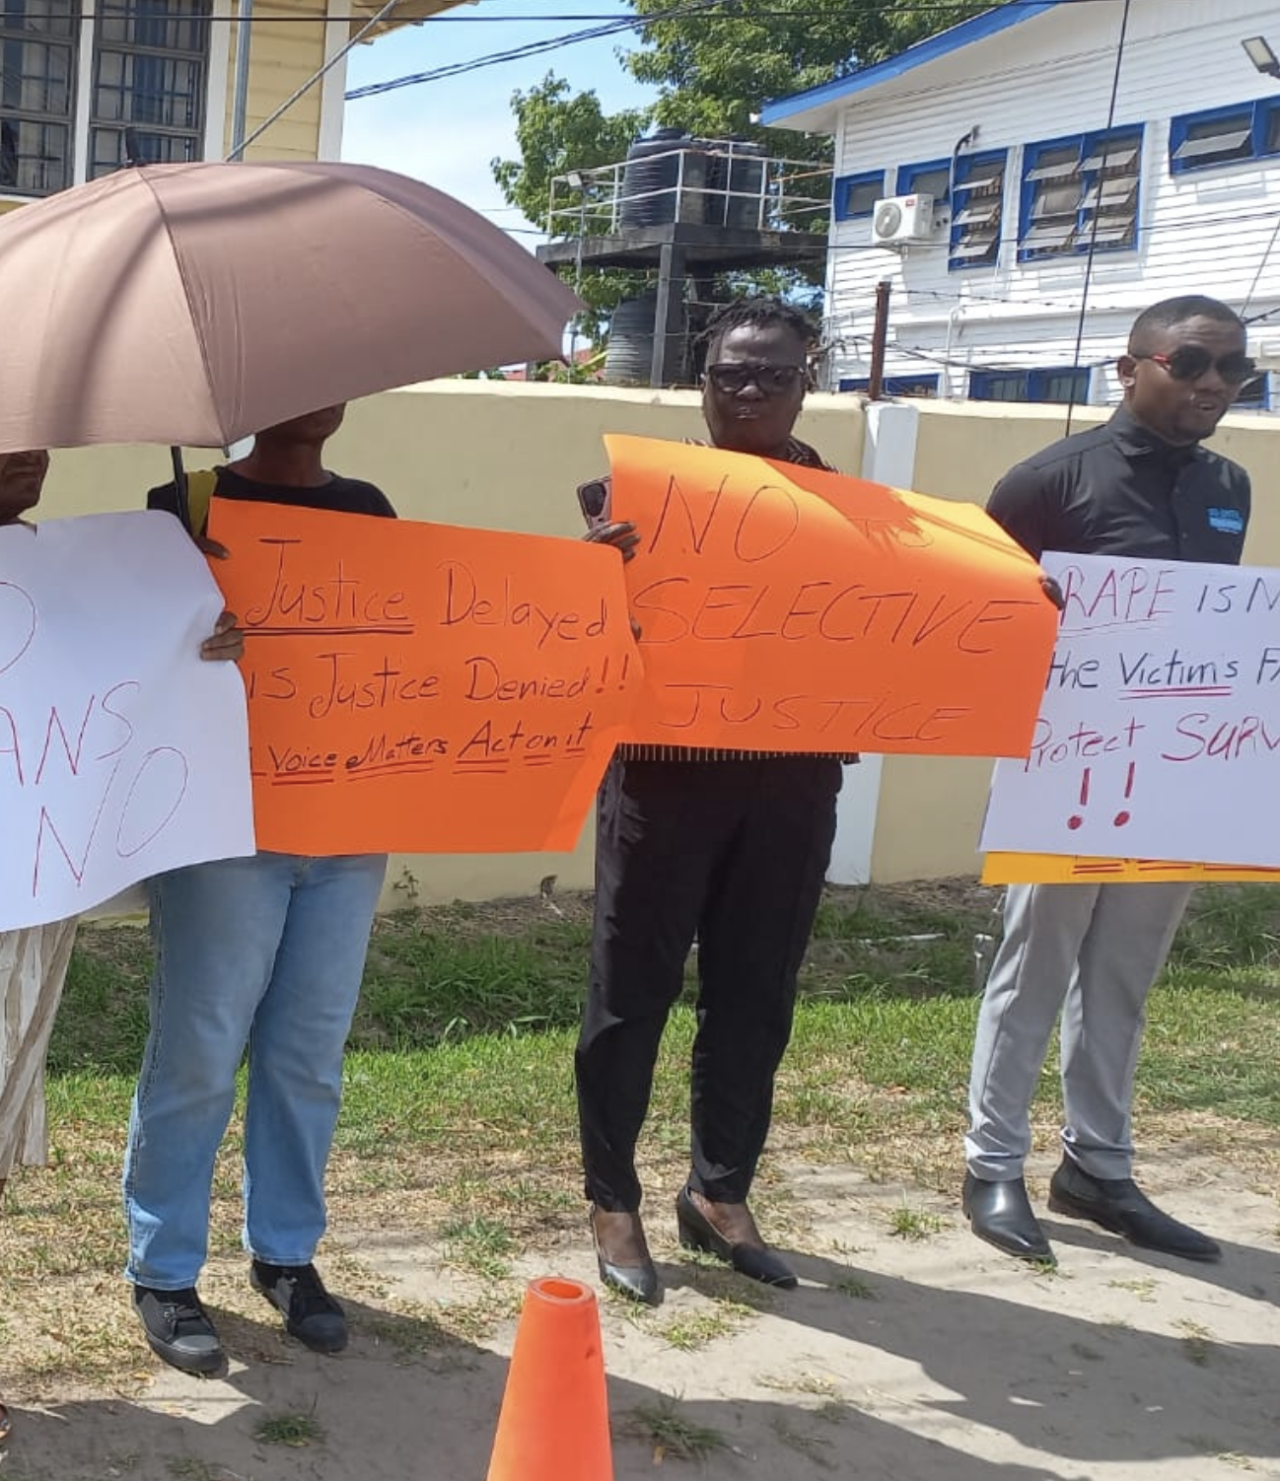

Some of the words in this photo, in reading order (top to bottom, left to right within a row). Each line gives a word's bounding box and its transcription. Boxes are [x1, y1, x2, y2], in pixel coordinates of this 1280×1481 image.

[649, 474, 799, 562] NO
[245, 538, 410, 627] Justice
[436, 560, 608, 649] Delayed
[632, 577, 1040, 654] SELECTIVE
[1059, 566, 1176, 627] RAPE
[308, 652, 440, 719] Justice
[657, 684, 975, 740] JUSTICE
[268, 744, 338, 772] Voice
[1023, 716, 1146, 773] Protect
[33, 746, 189, 897] NO
